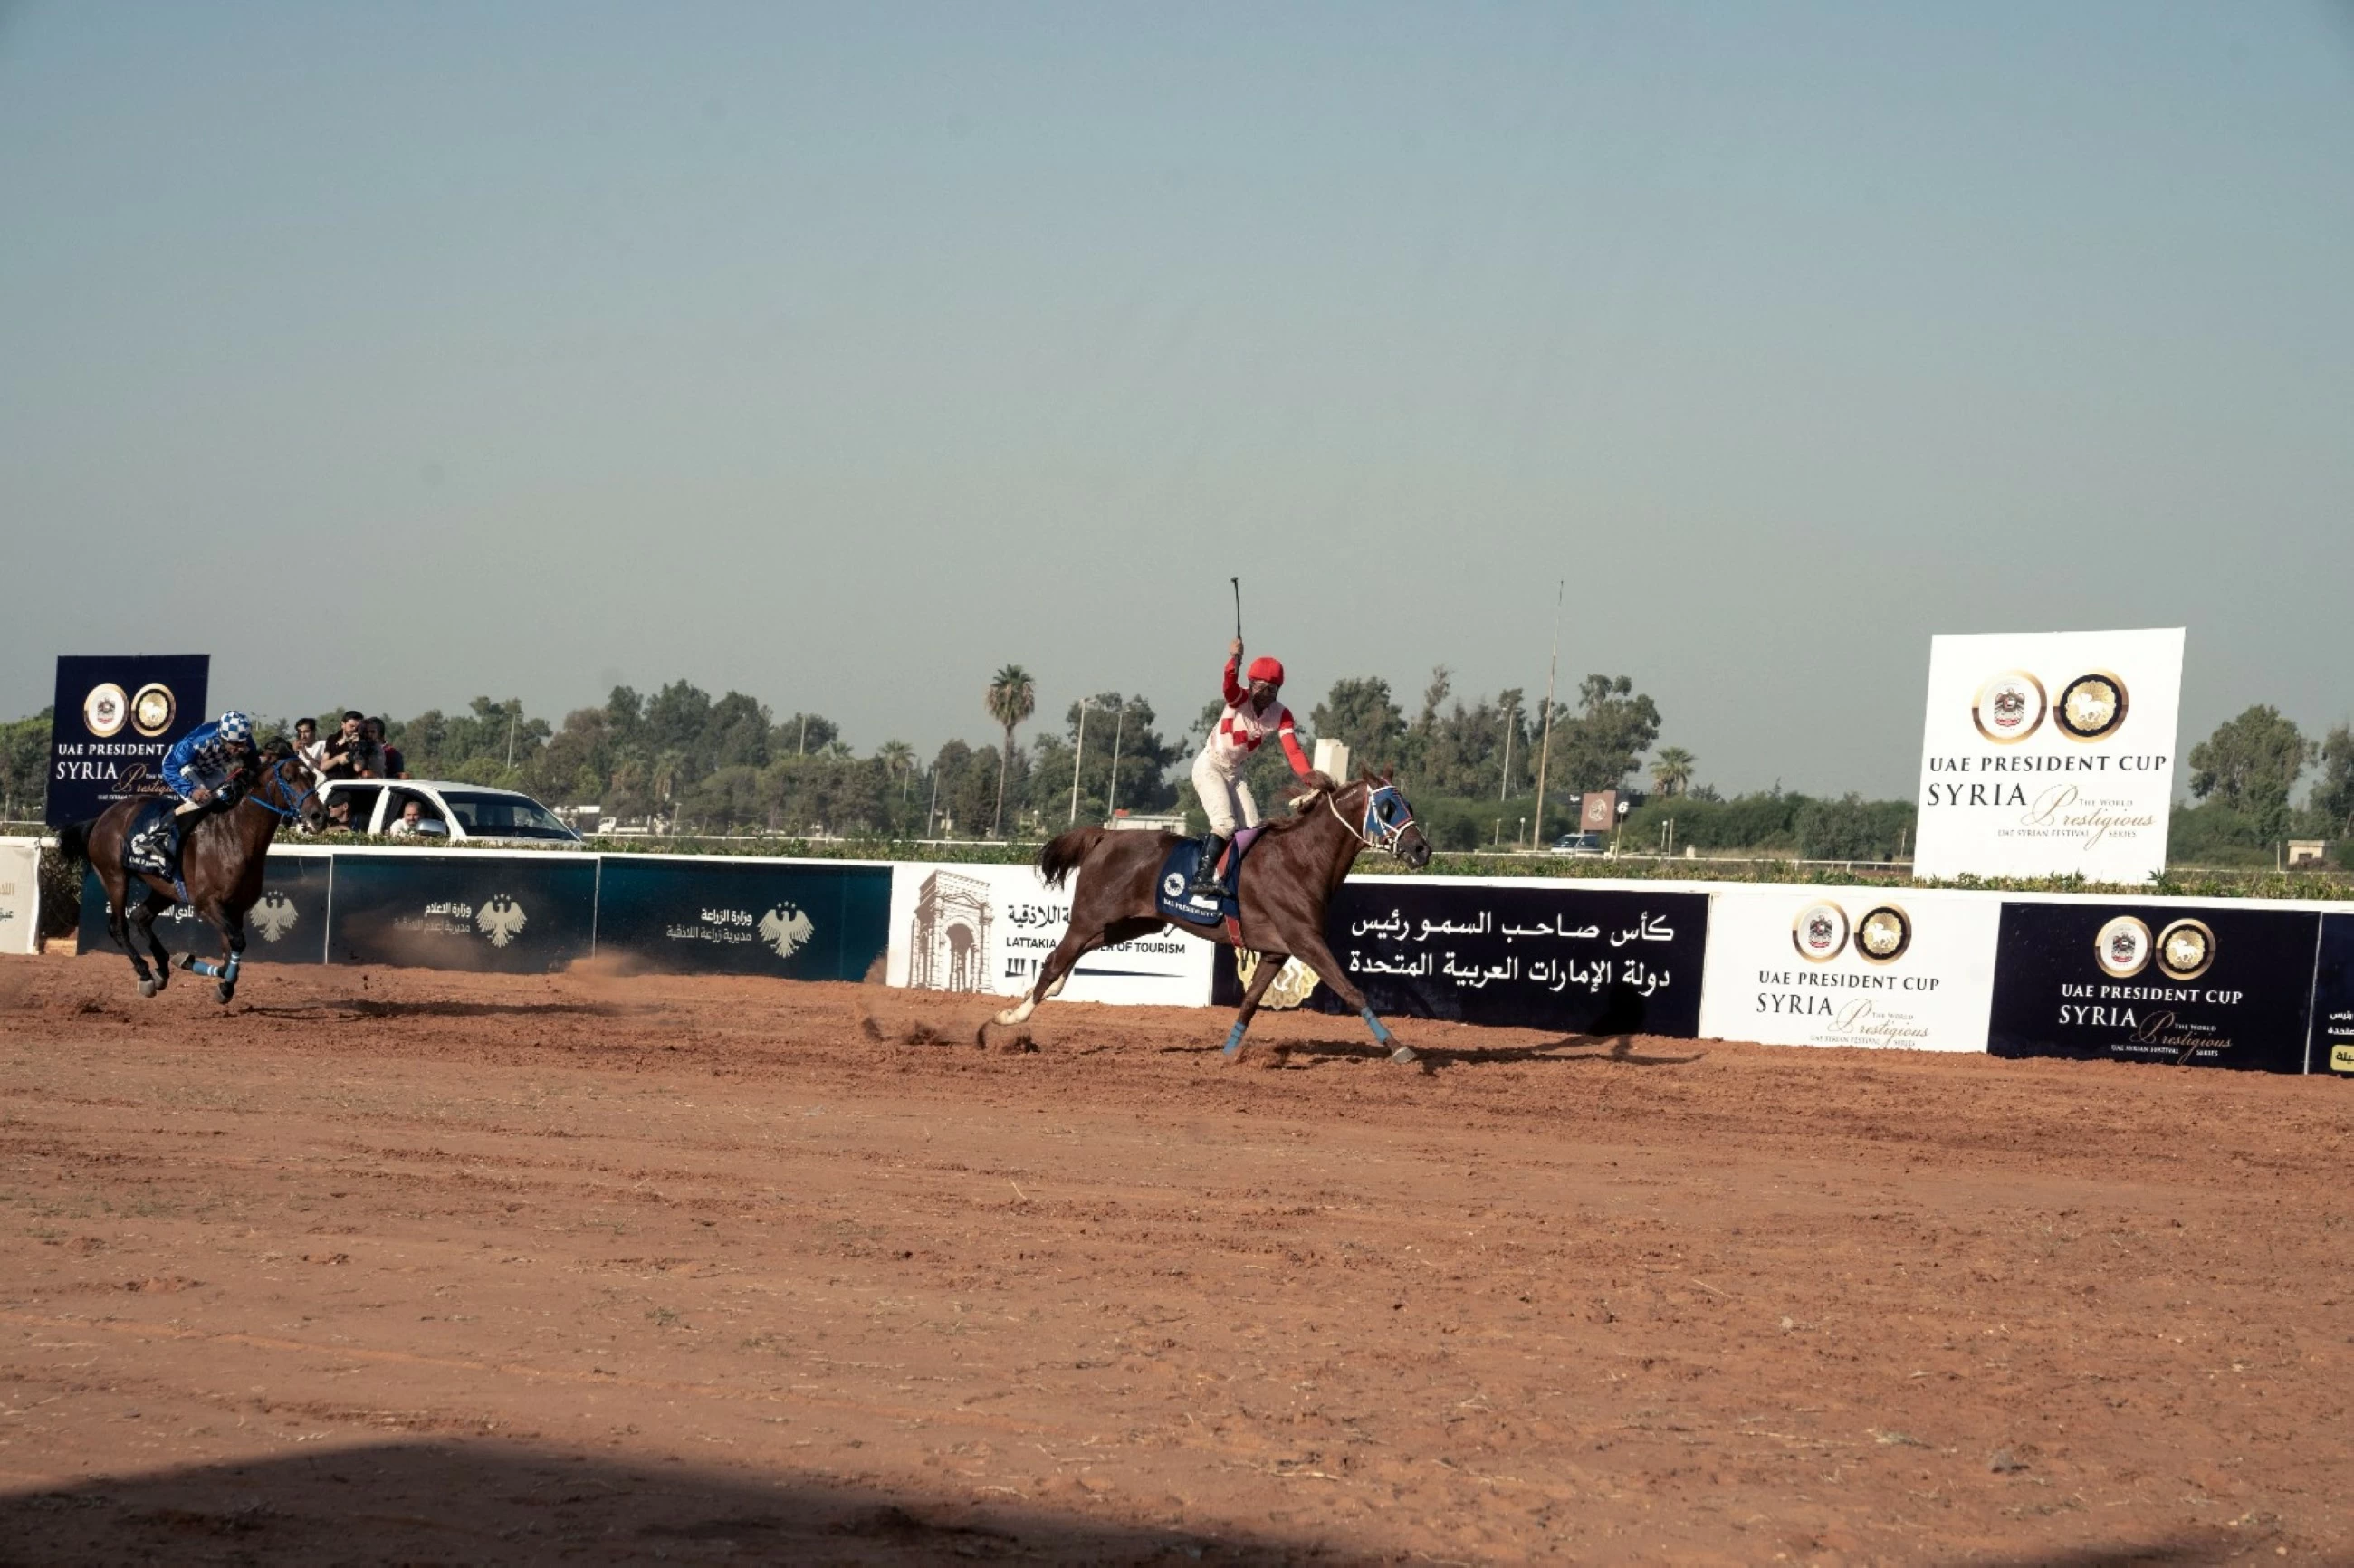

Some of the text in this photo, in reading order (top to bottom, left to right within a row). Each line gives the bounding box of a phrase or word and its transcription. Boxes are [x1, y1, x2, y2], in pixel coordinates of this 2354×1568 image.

[58, 744, 83, 756] UAE
[88, 743, 164, 756] PRESIDENT
[56, 761, 119, 779] SYRIA
[1929, 755, 2167, 771] UAE PRESIDENT CUP
[1927, 782, 2027, 806] SYRIA
[2080, 798, 2134, 807] THE WORLD
[1617, 802, 1629, 813] 6
[2020, 784, 2155, 851] Prestigious
[2017, 828, 2048, 837] SYRIAN
[2051, 828, 2090, 837] FESTIVAL
[2108, 829, 2137, 838] SERIES
[453, 902, 472, 918] وزارة
[701, 907, 752, 925] وزارة الزراعة
[1008, 905, 1061, 930] اللاذقية
[701, 926, 722, 942] زراعة
[723, 927, 751, 943] مديرية
[1352, 908, 1674, 946] كأس صاحب السمو رئيس
[1006, 936, 1057, 949] LATTAKIA
[1116, 942, 1133, 952] OF
[1134, 942, 1185, 954] TOURISM
[1349, 951, 1670, 996] دولة الإمارات العربية المتحدة
[1759, 970, 1939, 991] UAE PRESIDENT CUP
[2062, 983, 2244, 1004] UAE PRESIDENT CUP
[1756, 992, 1833, 1016] SYRIA
[1827, 999, 1929, 1049] Prestigious
[2058, 1004, 2137, 1028] SYRIA
[2191, 1023, 2216, 1031] WORLD
[2129, 1010, 2233, 1065] Prestigious
